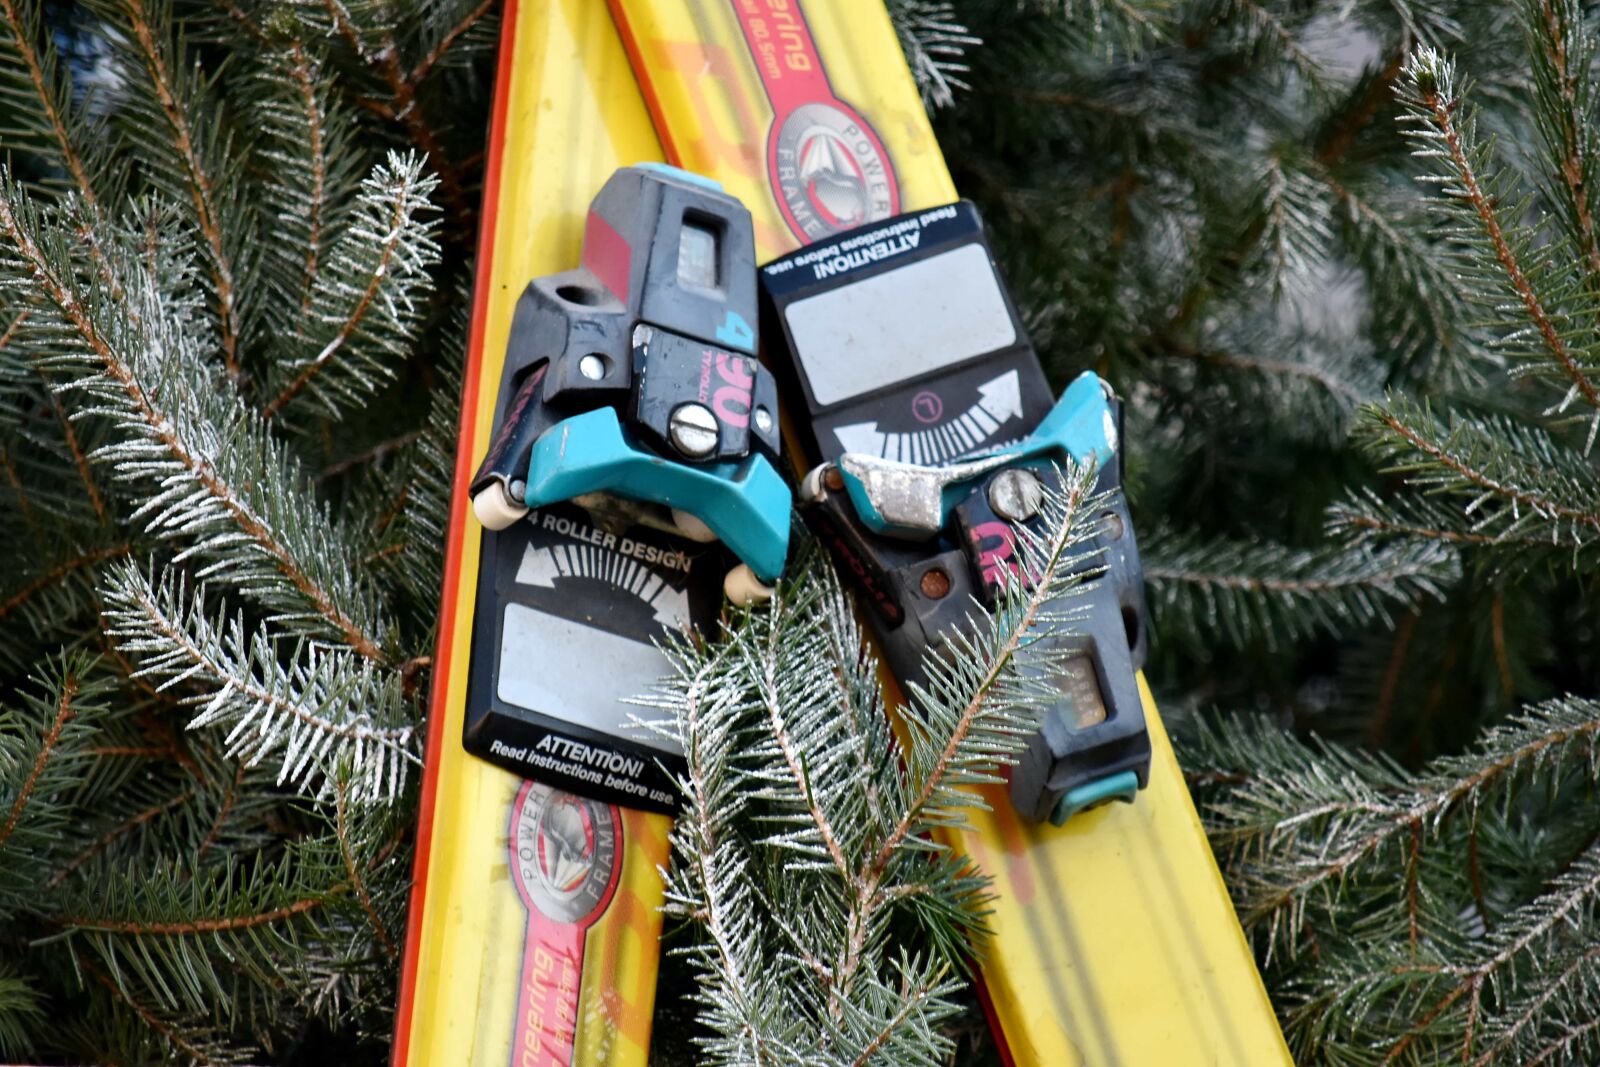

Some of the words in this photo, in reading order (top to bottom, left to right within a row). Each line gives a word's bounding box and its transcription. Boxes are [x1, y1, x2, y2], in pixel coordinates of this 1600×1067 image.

[778, 148, 822, 235] FRAME
[842, 124, 889, 213] POWER
[842, 219, 921, 252] instructions
[919, 206, 957, 228] Read
[764, 260, 793, 276] use.
[794, 245, 840, 267] before
[813, 231, 921, 280] ATTENTION!
[713, 353, 753, 429] 90
[527, 511, 540, 526] 4
[542, 513, 617, 549] ROLLER
[620, 538, 693, 573] DESIGN
[490, 740, 527, 761] Read
[527, 749, 604, 785] instructions
[604, 774, 648, 798] before
[649, 788, 675, 806] use.
[536, 734, 645, 778] ATTENTION!
[519, 790, 545, 880] POWER
[587, 803, 613, 900] FRAME
